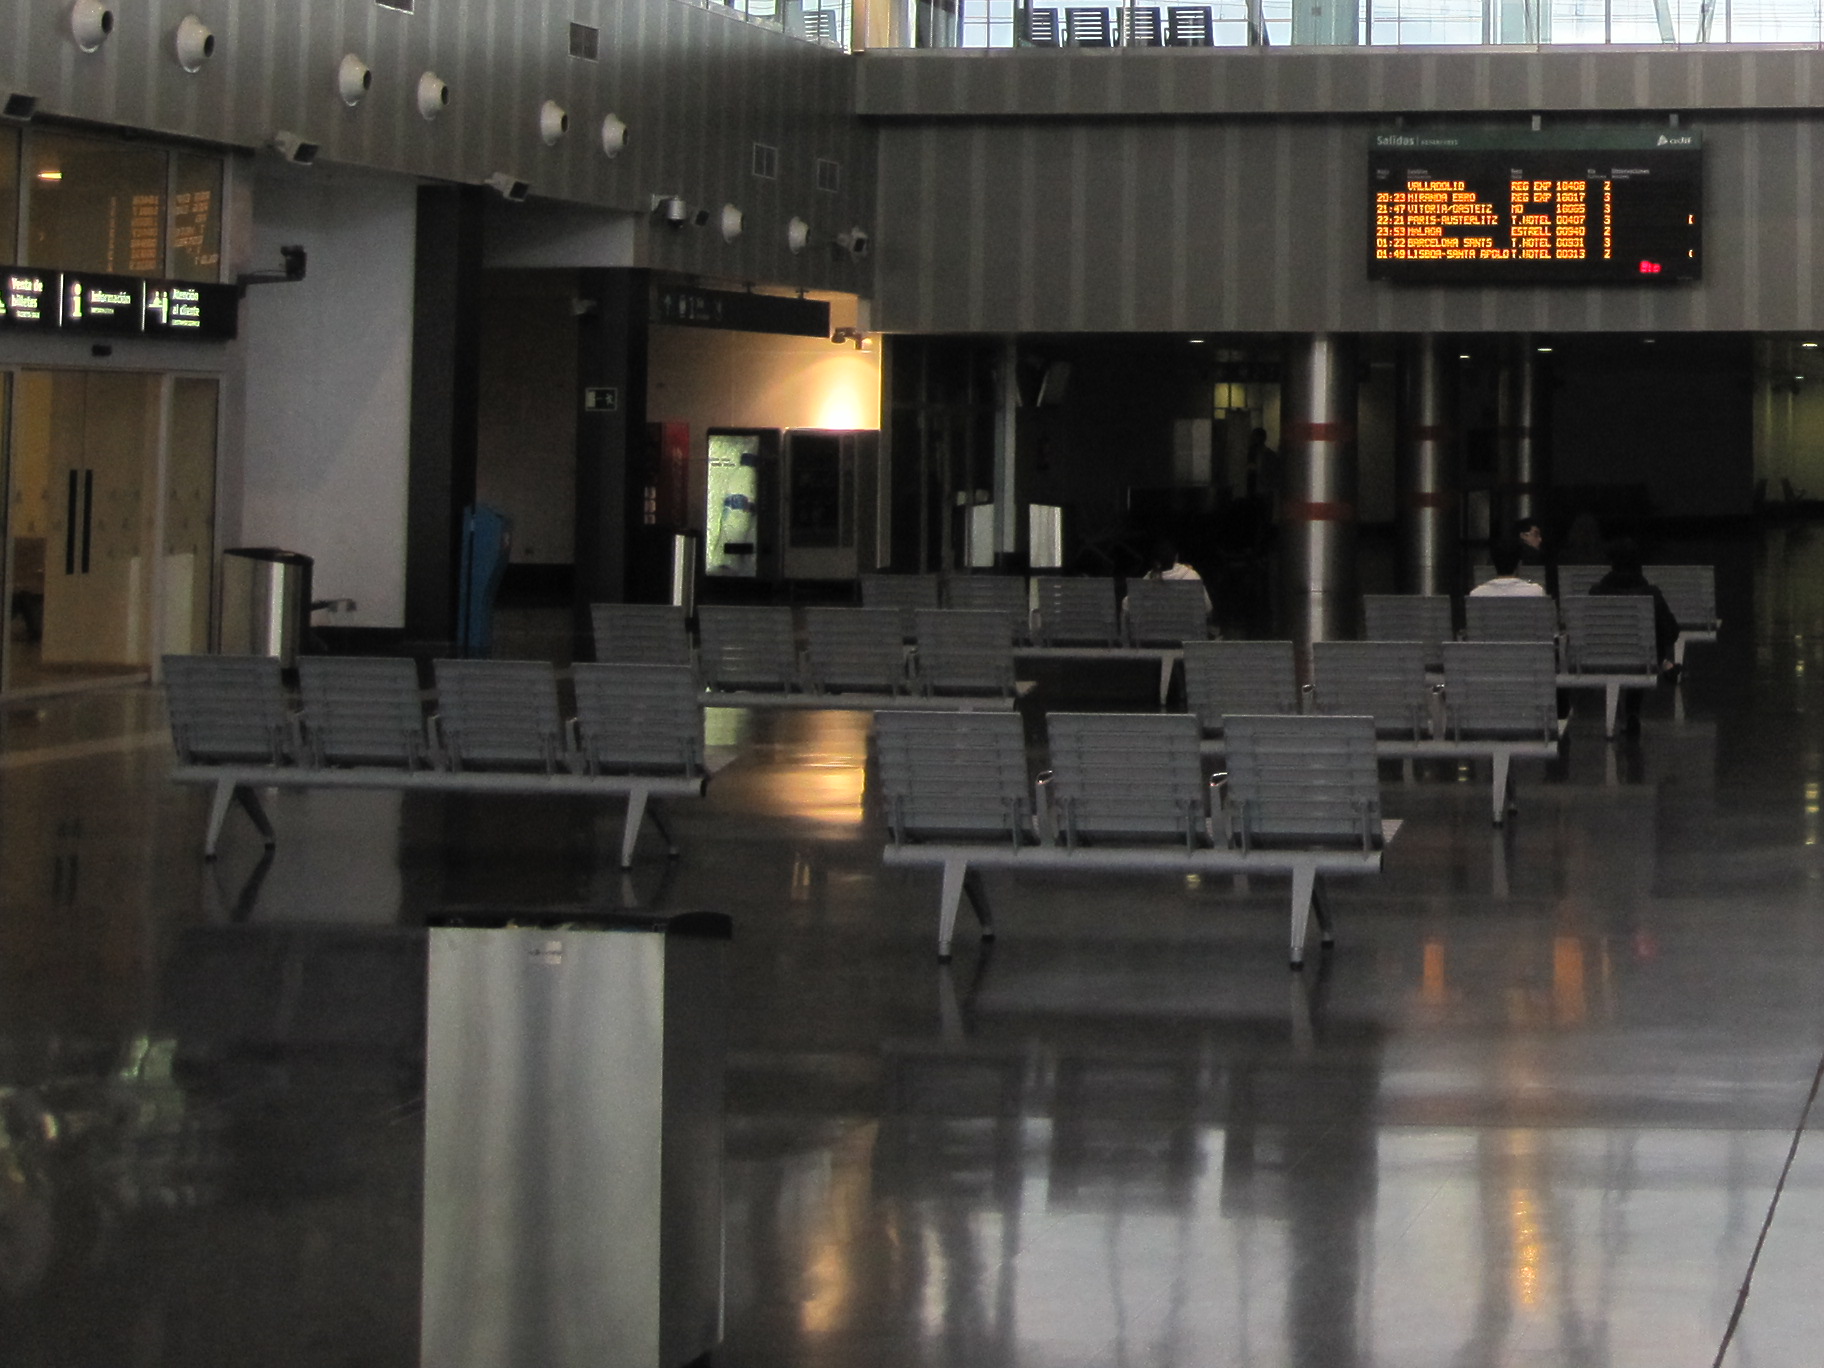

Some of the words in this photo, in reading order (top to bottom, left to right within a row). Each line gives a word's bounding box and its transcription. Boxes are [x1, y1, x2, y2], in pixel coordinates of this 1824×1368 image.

[1376, 135, 1414, 146] Salidas
[1407, 181, 1465, 191] VALLADOLID
[1510, 181, 1529, 191] REG
[1604, 181, 1611, 191] 2
[1376, 193, 1406, 202] 20:23
[1407, 193, 1448, 202] MIRANDA
[1452, 193, 1476, 202] EBRO
[1510, 193, 1529, 202] REG
[1604, 193, 1611, 202] 3
[1376, 204, 1406, 213] 21:47
[1604, 204, 1611, 213] 3
[1376, 215, 1406, 225] 22:21
[1407, 215, 1498, 225] PARIS-AUSTERLITZ
[1510, 215, 1552, 225] T.HOTEL
[1604, 215, 1611, 225] 3
[1376, 227, 1406, 236] 23:53
[1510, 227, 1552, 236] ESTRELL
[1604, 227, 1611, 236] 2
[1376, 238, 1406, 247] 01:22
[1407, 238, 1459, 247] BARCELONA
[1463, 238, 1493, 247] SANTS
[1510, 238, 1552, 247] T.HOTEL
[1604, 238, 1611, 247] 3
[1376, 249, 1406, 259] 01:49
[1407, 249, 1476, 259] LISBOA-SANTA
[1510, 249, 1552, 259] T.HOTEL
[1604, 249, 1611, 259] 2
[91, 290, 132, 304] Información
